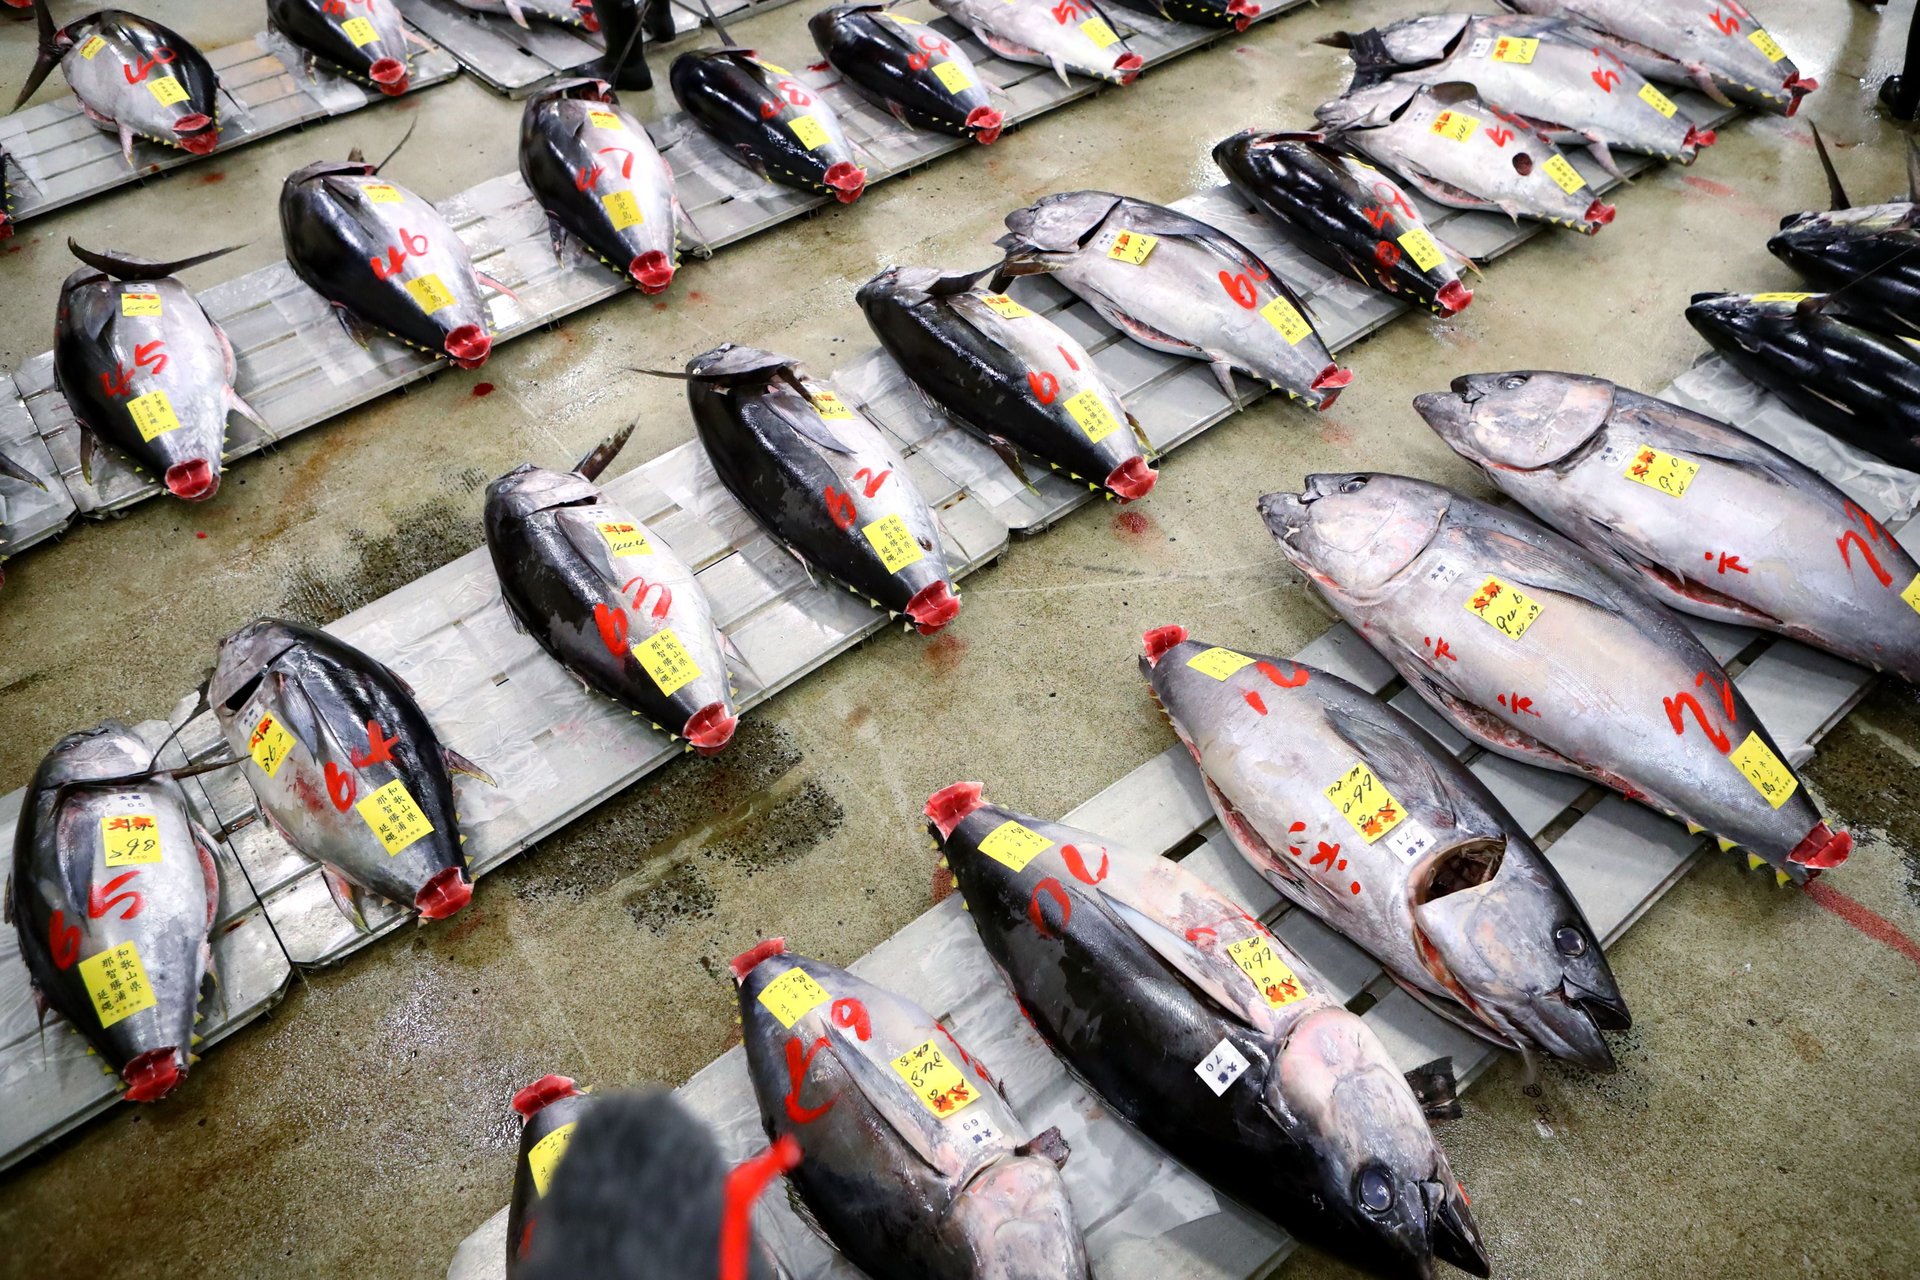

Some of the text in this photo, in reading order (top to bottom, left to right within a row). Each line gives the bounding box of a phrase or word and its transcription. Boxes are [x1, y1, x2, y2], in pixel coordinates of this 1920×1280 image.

[123, 46, 176, 85] 40
[907, 34, 951, 71] 49
[759, 80, 811, 120] 48
[576, 147, 635, 192] 47
[1363, 182, 1415, 230] 59
[370, 227, 429, 281] 46
[1218, 257, 1269, 310] 60
[99, 340, 169, 398] 45
[1026, 345, 1080, 405] 61
[824, 467, 892, 529] 62
[594, 576, 672, 657] 63
[324, 719, 400, 814] 64
[1742, 756, 1775, 795] バリ島
[388, 786, 417, 822] 和歌山県
[48, 870, 145, 970] 65
[101, 956, 127, 1002] 那智勝浦
[116, 949, 142, 993] 和歌山県
[1205, 1054, 1223, 1072] 70
[962, 1118, 979, 1131] 69
